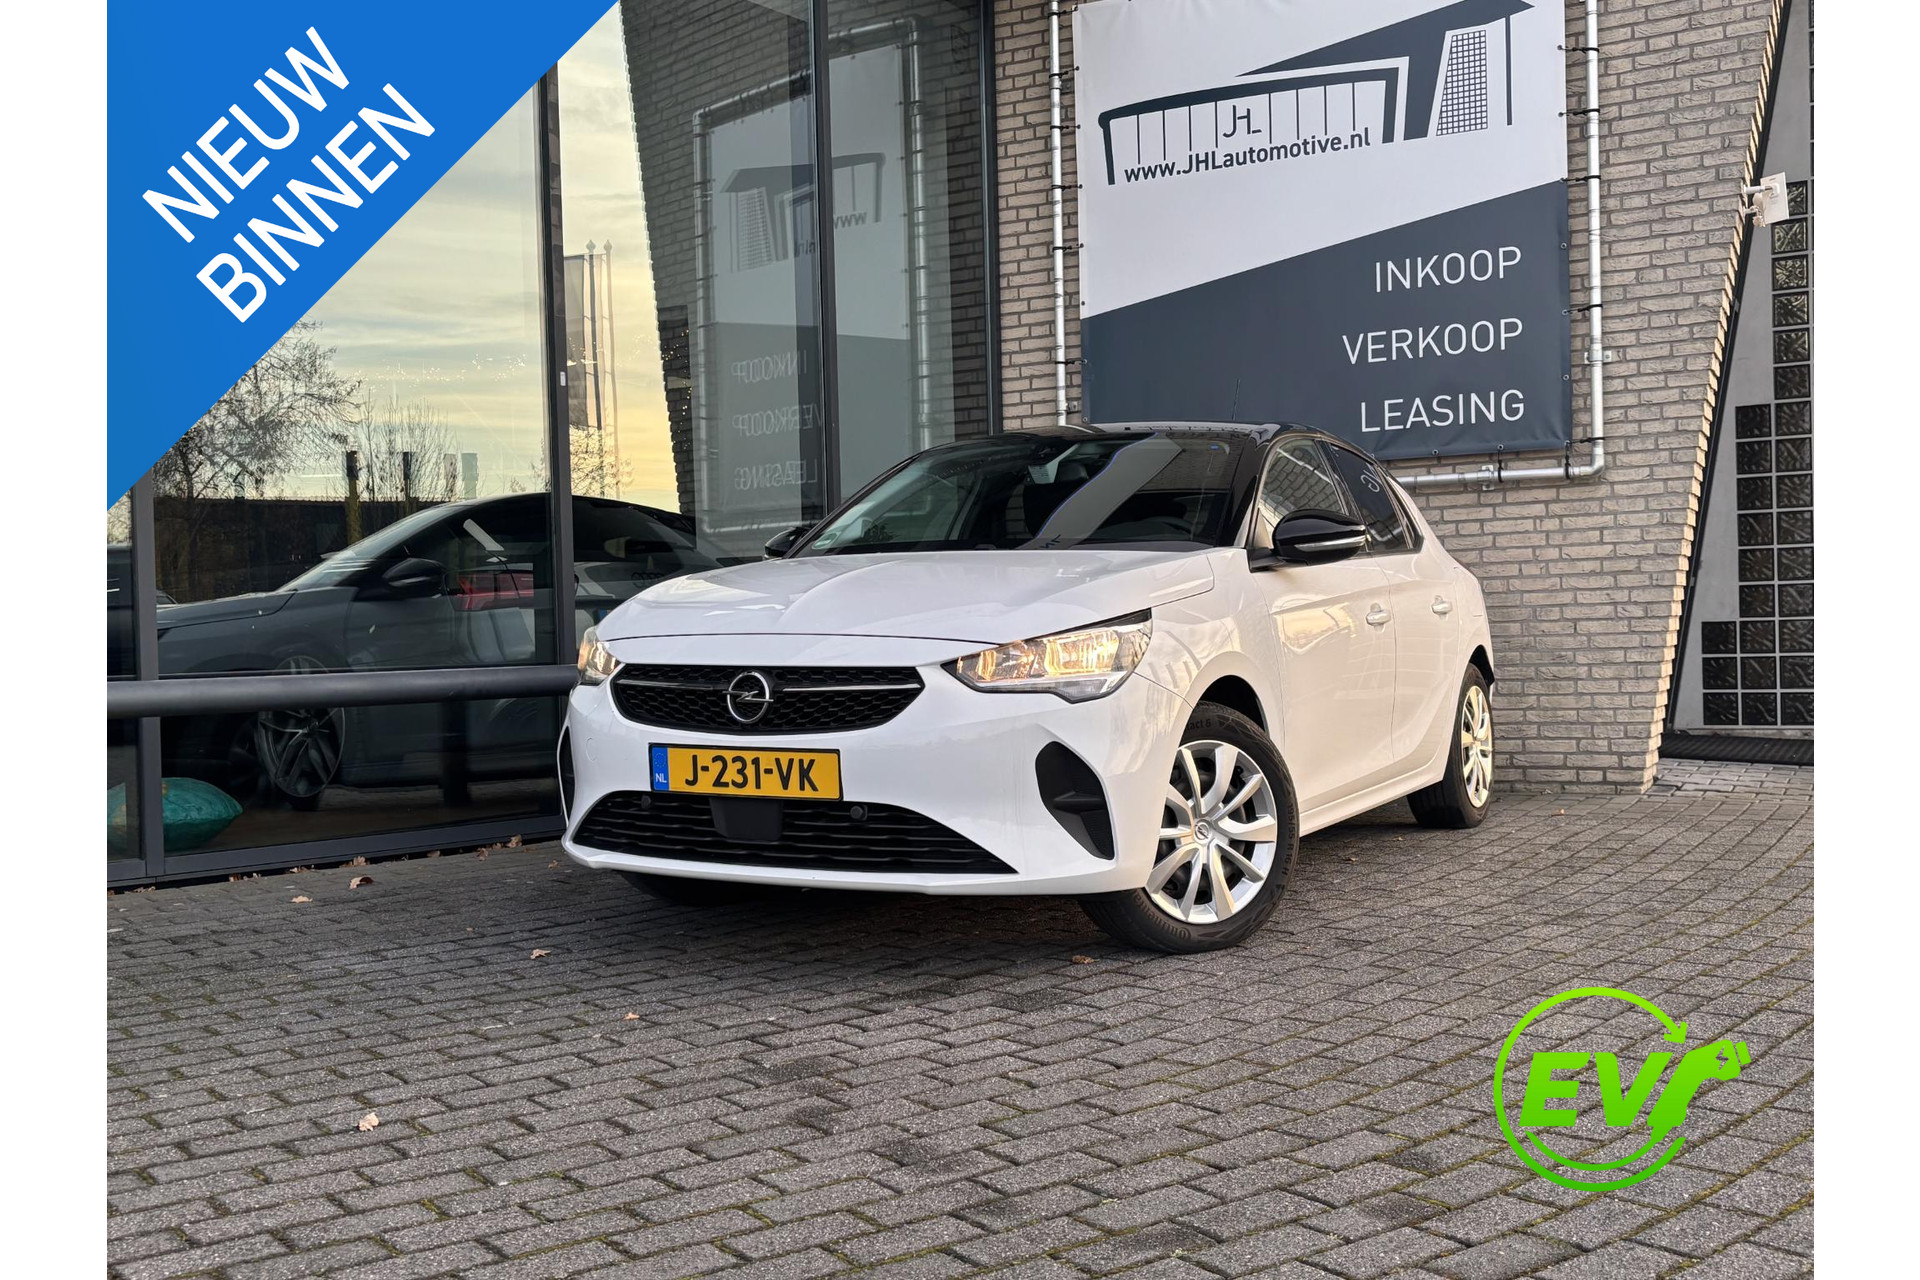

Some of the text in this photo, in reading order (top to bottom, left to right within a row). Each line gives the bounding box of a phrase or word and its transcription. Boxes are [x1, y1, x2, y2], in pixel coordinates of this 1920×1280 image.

[1124, 127, 1371, 182] www.JHLautomotive.nl
[1375, 246, 1522, 293] INKOOP
[1342, 318, 1524, 365] VERKOOP
[1361, 389, 1526, 433] LEASING
[655, 773, 667, 784] NL
[685, 755, 818, 792] J-231-VK
